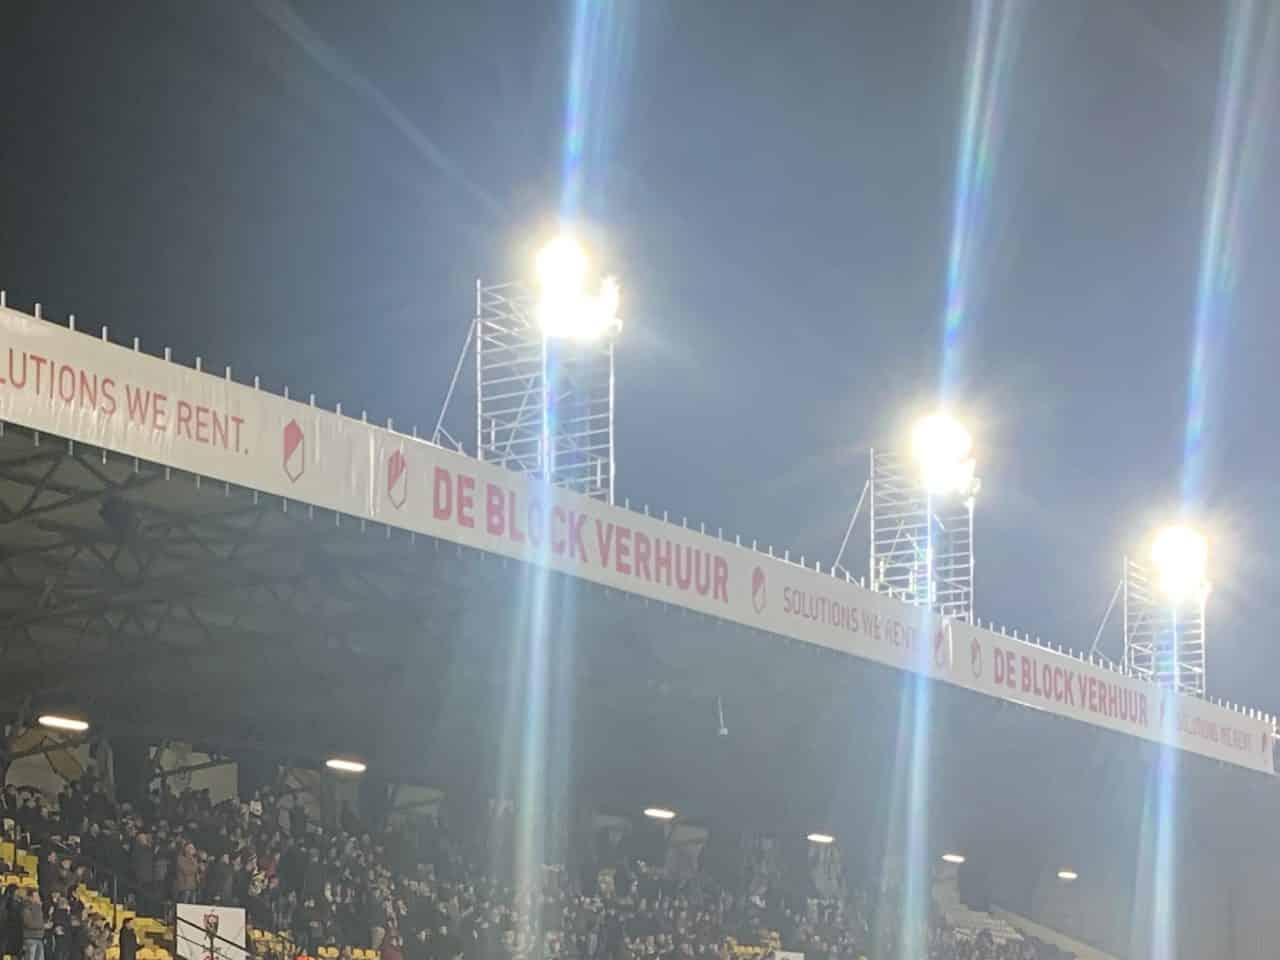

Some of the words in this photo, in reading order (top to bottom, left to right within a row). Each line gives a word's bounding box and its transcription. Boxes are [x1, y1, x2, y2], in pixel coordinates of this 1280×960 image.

[125, 383, 168, 433] WE
[177, 401, 249, 456] RENT.
[432, 466, 475, 529] DE
[486, 482, 589, 563] BLOCK
[595, 518, 729, 604] VERHUUR
[783, 586, 860, 633] SOLUTIONS
[993, 647, 1016, 688] DE
[1021, 655, 1074, 708] BLOCK
[1078, 673, 1149, 727] VERHUUR
